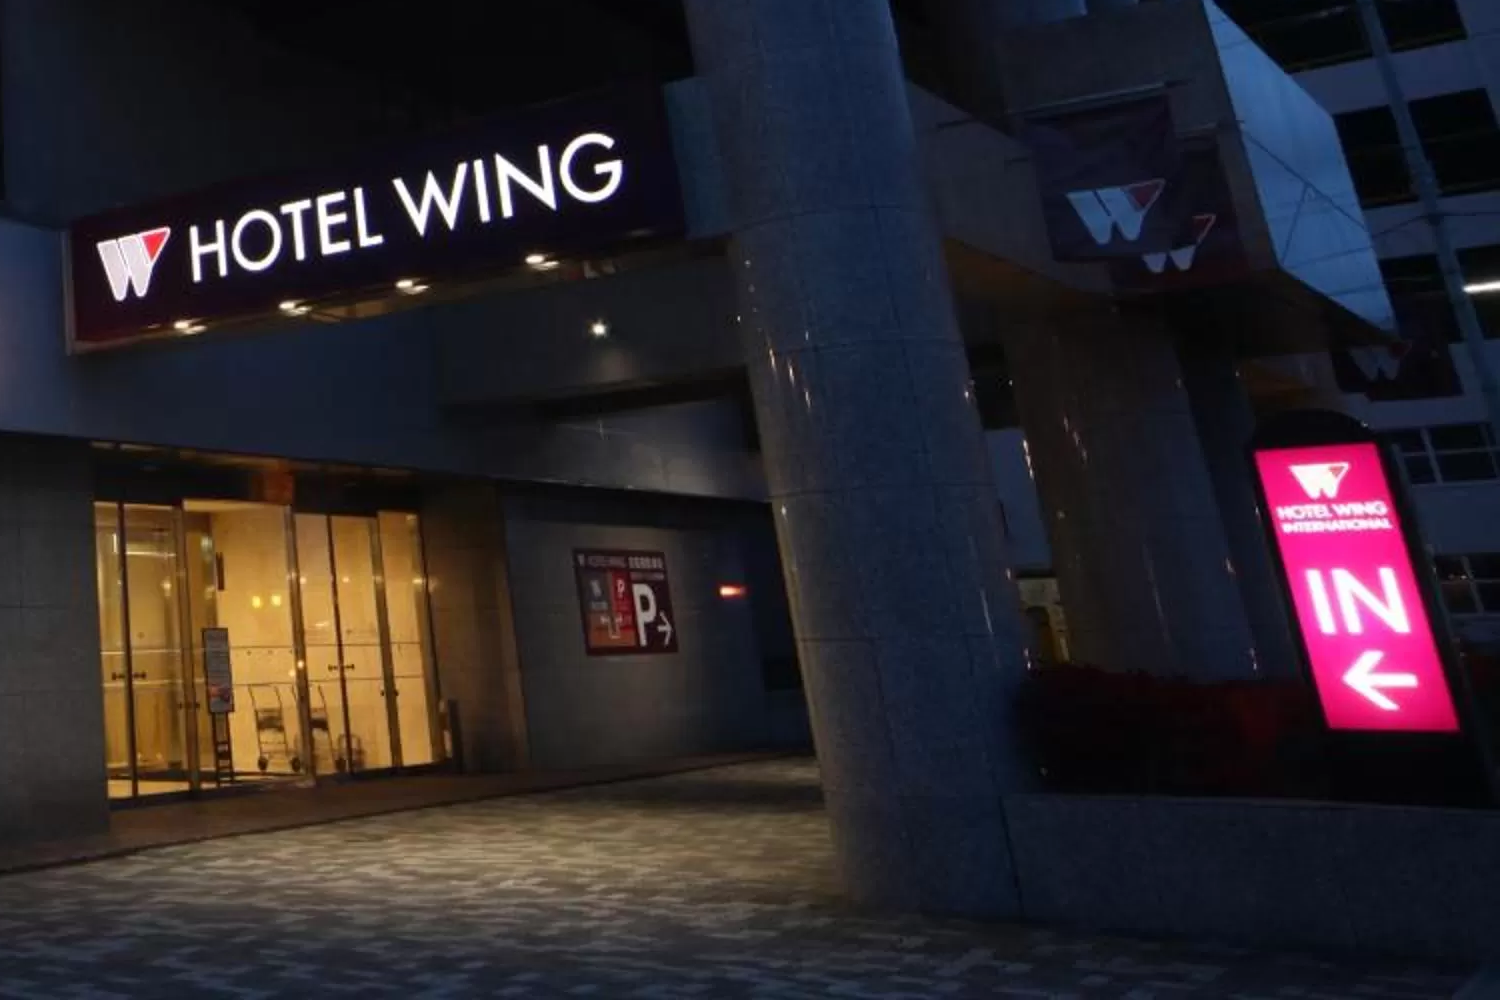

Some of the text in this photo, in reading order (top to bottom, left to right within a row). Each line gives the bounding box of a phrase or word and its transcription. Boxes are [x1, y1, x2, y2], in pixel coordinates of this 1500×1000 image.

[189, 187, 384, 283] HOTEL
[392, 132, 623, 237] WING
[1276, 501, 1388, 520] HOTEL WING
[1282, 518, 1393, 533] INTERNATIONAL
[632, 583, 658, 647] P
[1304, 567, 1412, 636] IN
